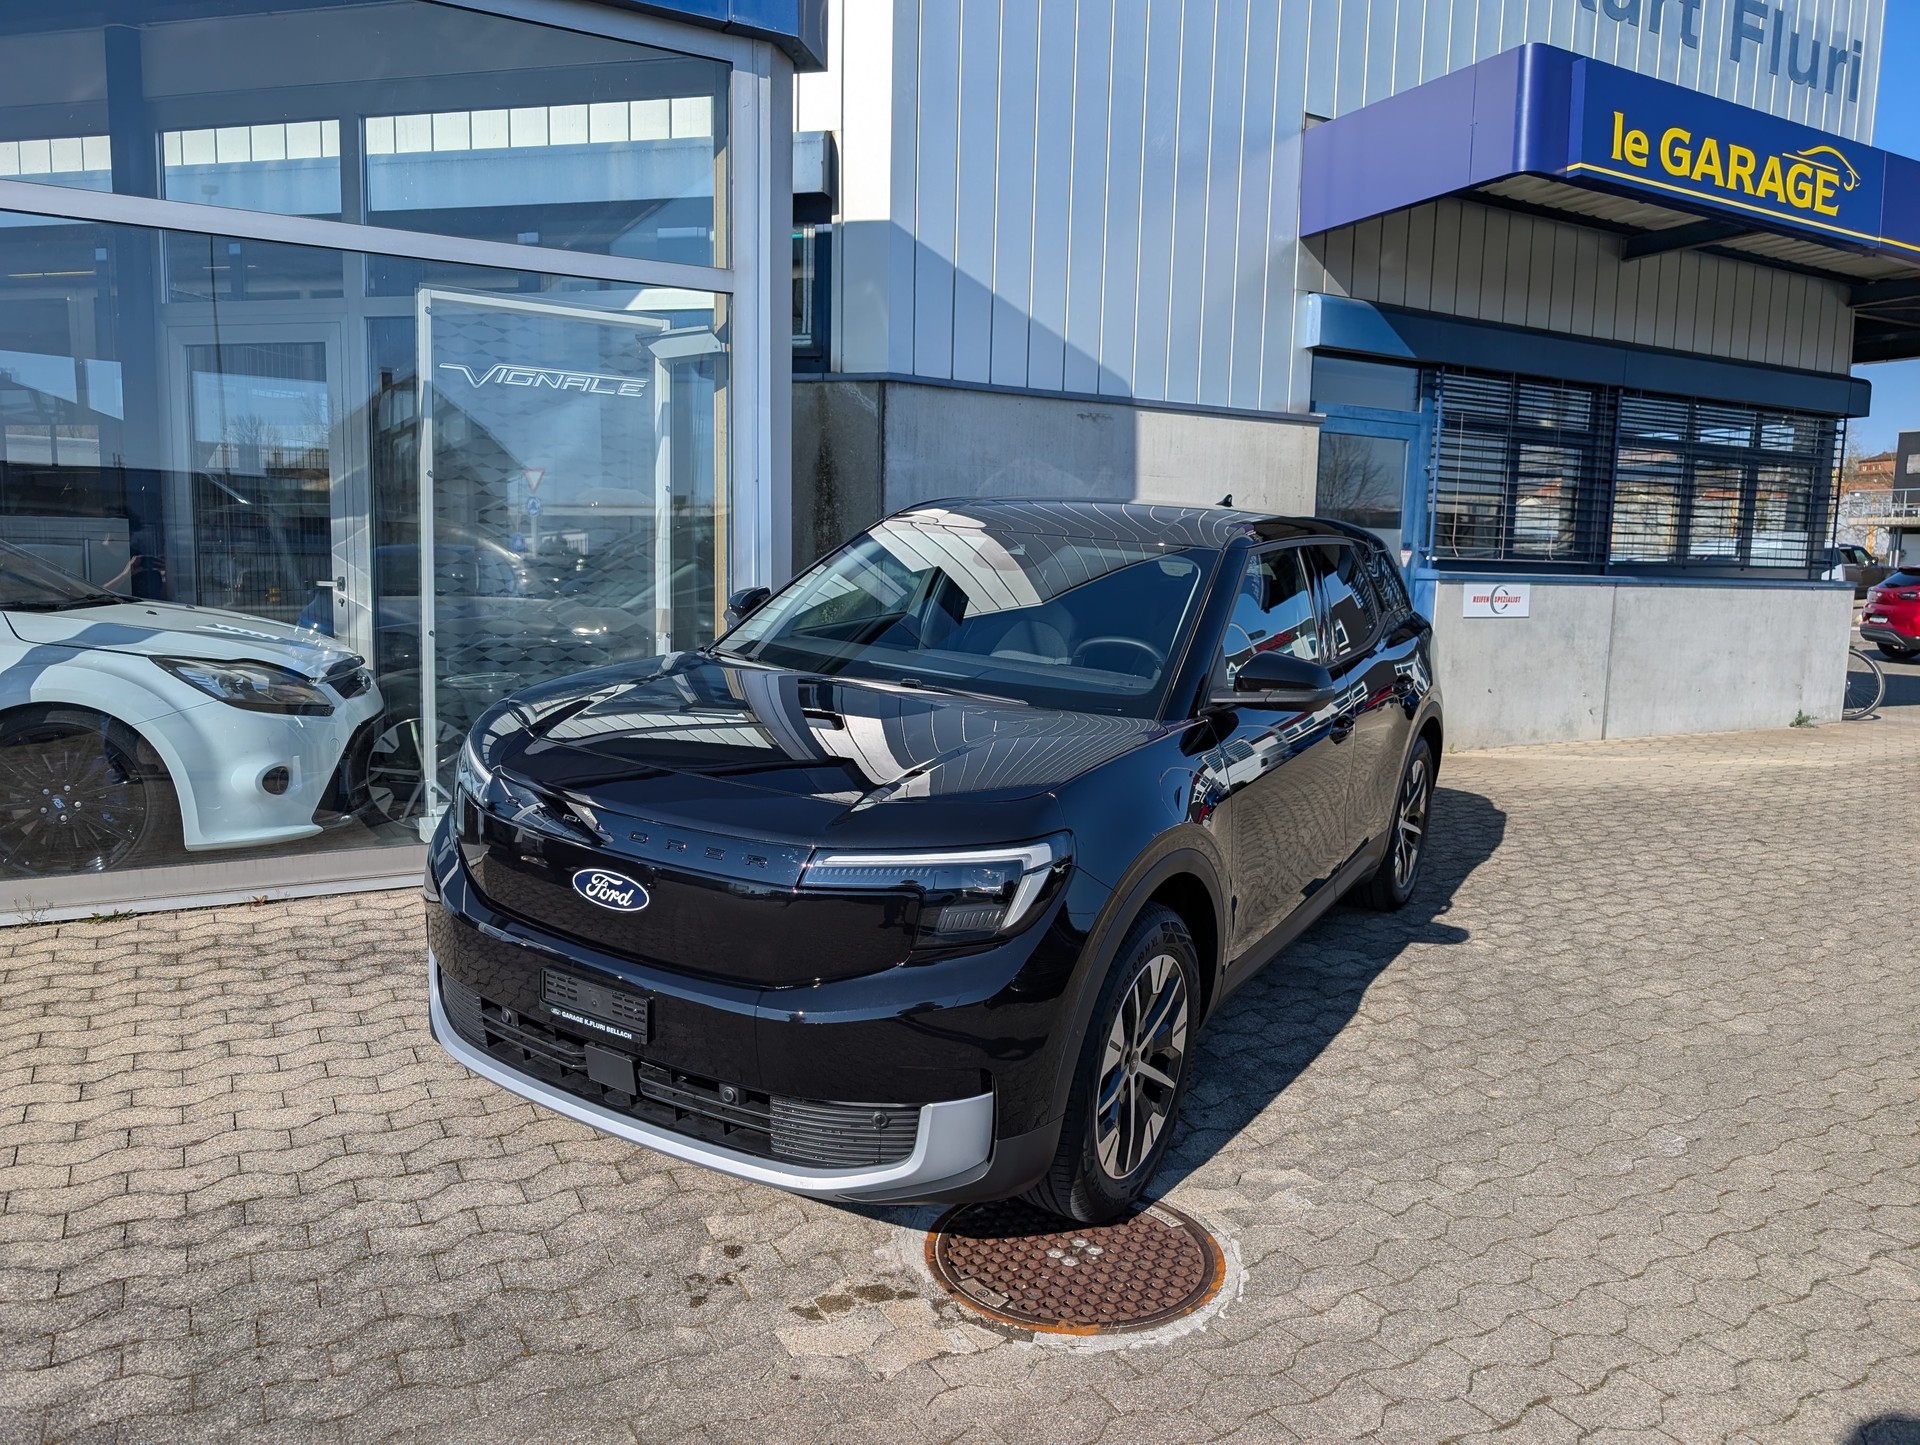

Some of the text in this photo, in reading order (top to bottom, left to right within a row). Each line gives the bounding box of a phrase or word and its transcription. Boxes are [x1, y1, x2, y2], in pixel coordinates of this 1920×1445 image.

[1730, 0, 1862, 103] Fluri
[1611, 111, 1840, 217] le GARAGE
[439, 363, 649, 397] VIGNALE
[1472, 595, 1521, 603] REIFEN SPEZIALIST
[586, 873, 634, 906] Ford
[561, 1011, 583, 1024] GARAGE
[606, 1026, 632, 1040] BELLACH
